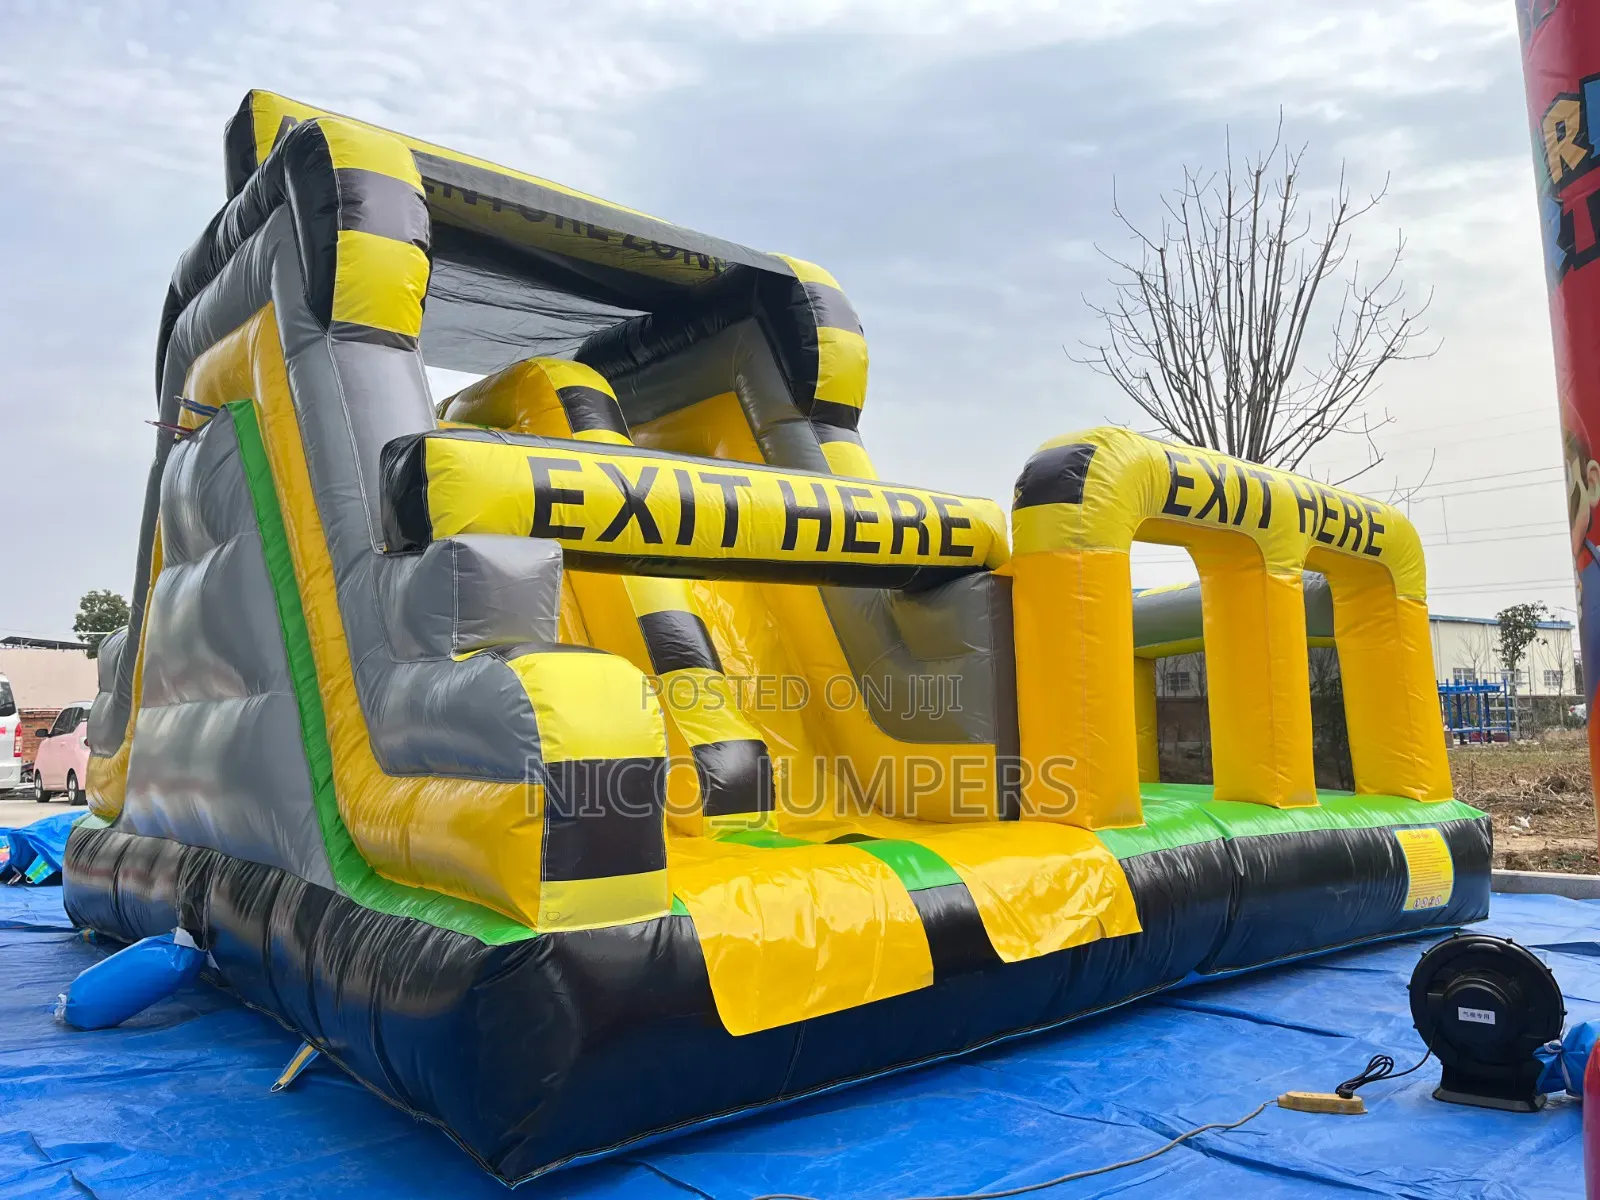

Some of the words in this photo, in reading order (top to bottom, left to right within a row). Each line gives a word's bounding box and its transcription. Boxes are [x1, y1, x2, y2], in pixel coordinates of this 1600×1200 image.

[526, 455, 752, 548] EXIT
[776, 479, 975, 557] HERE
[1161, 450, 1276, 530] EXIT
[1287, 478, 1386, 557] HERE
